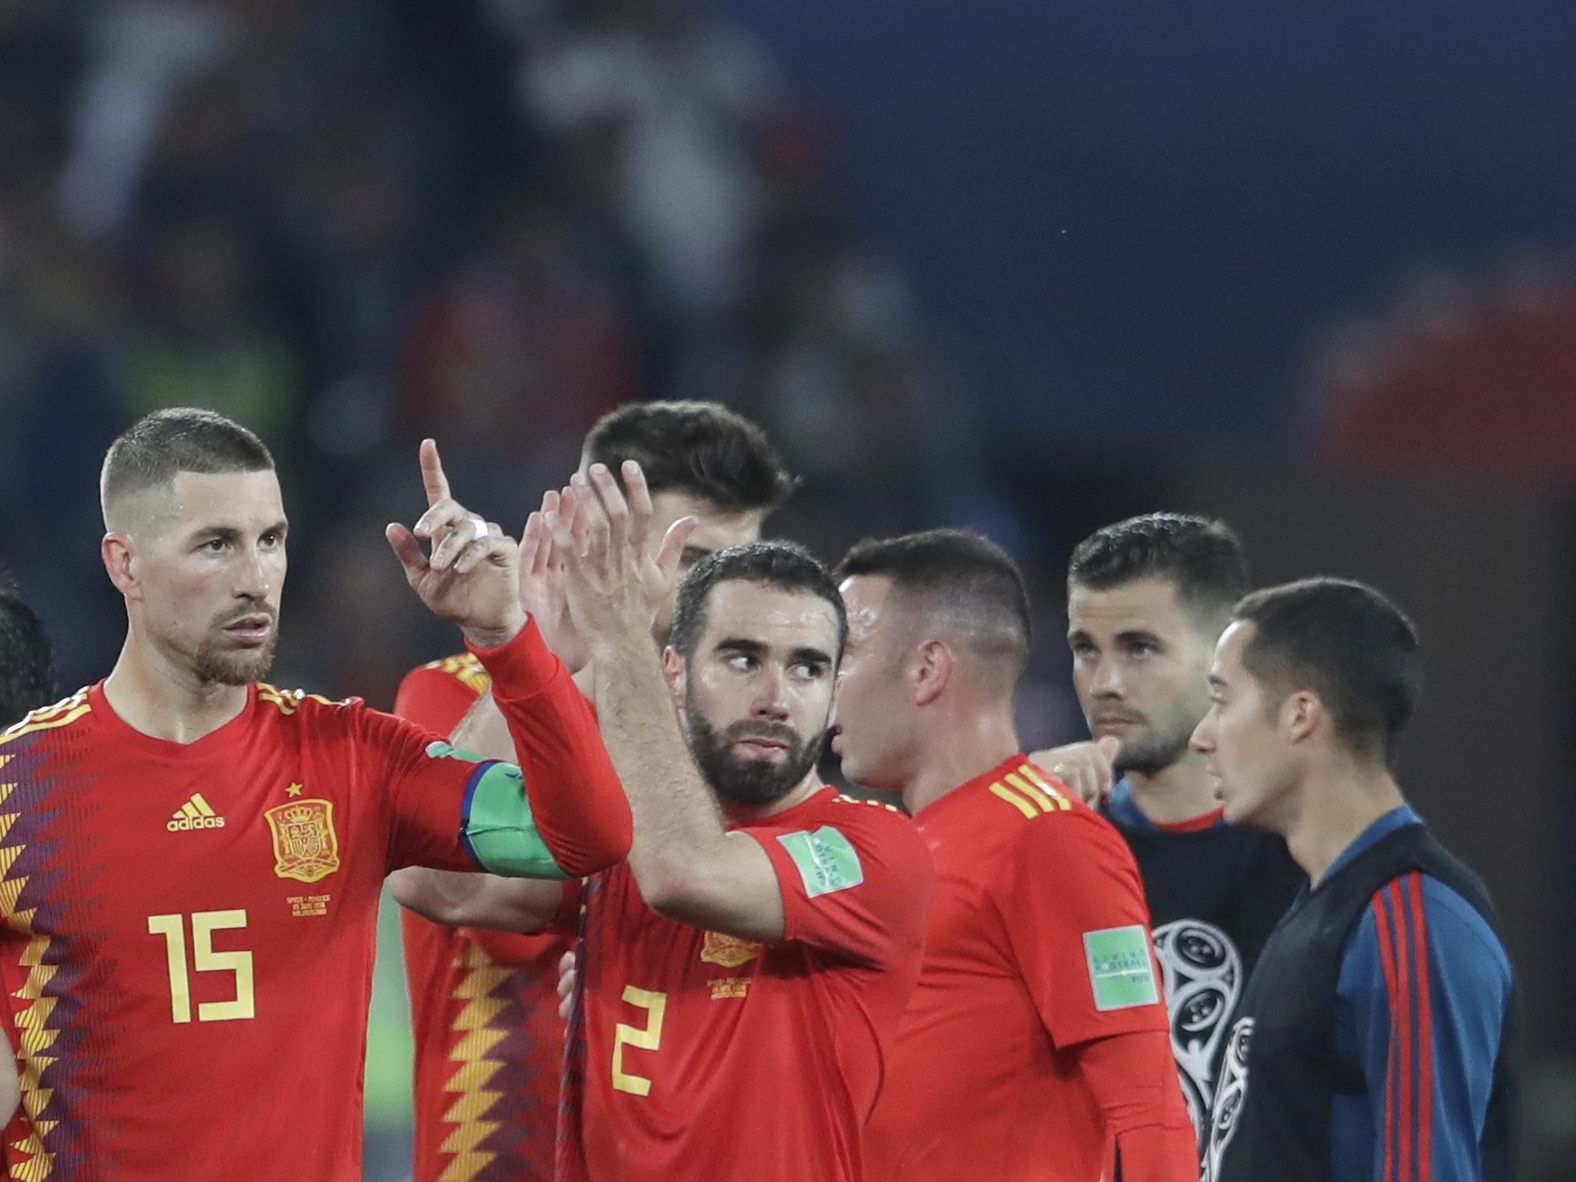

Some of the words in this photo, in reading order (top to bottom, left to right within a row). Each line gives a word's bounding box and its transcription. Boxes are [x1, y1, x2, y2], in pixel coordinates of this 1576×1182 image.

[167, 815, 225, 832] adidas
[147, 908, 255, 1024] 15
[611, 984, 668, 1097] 2
